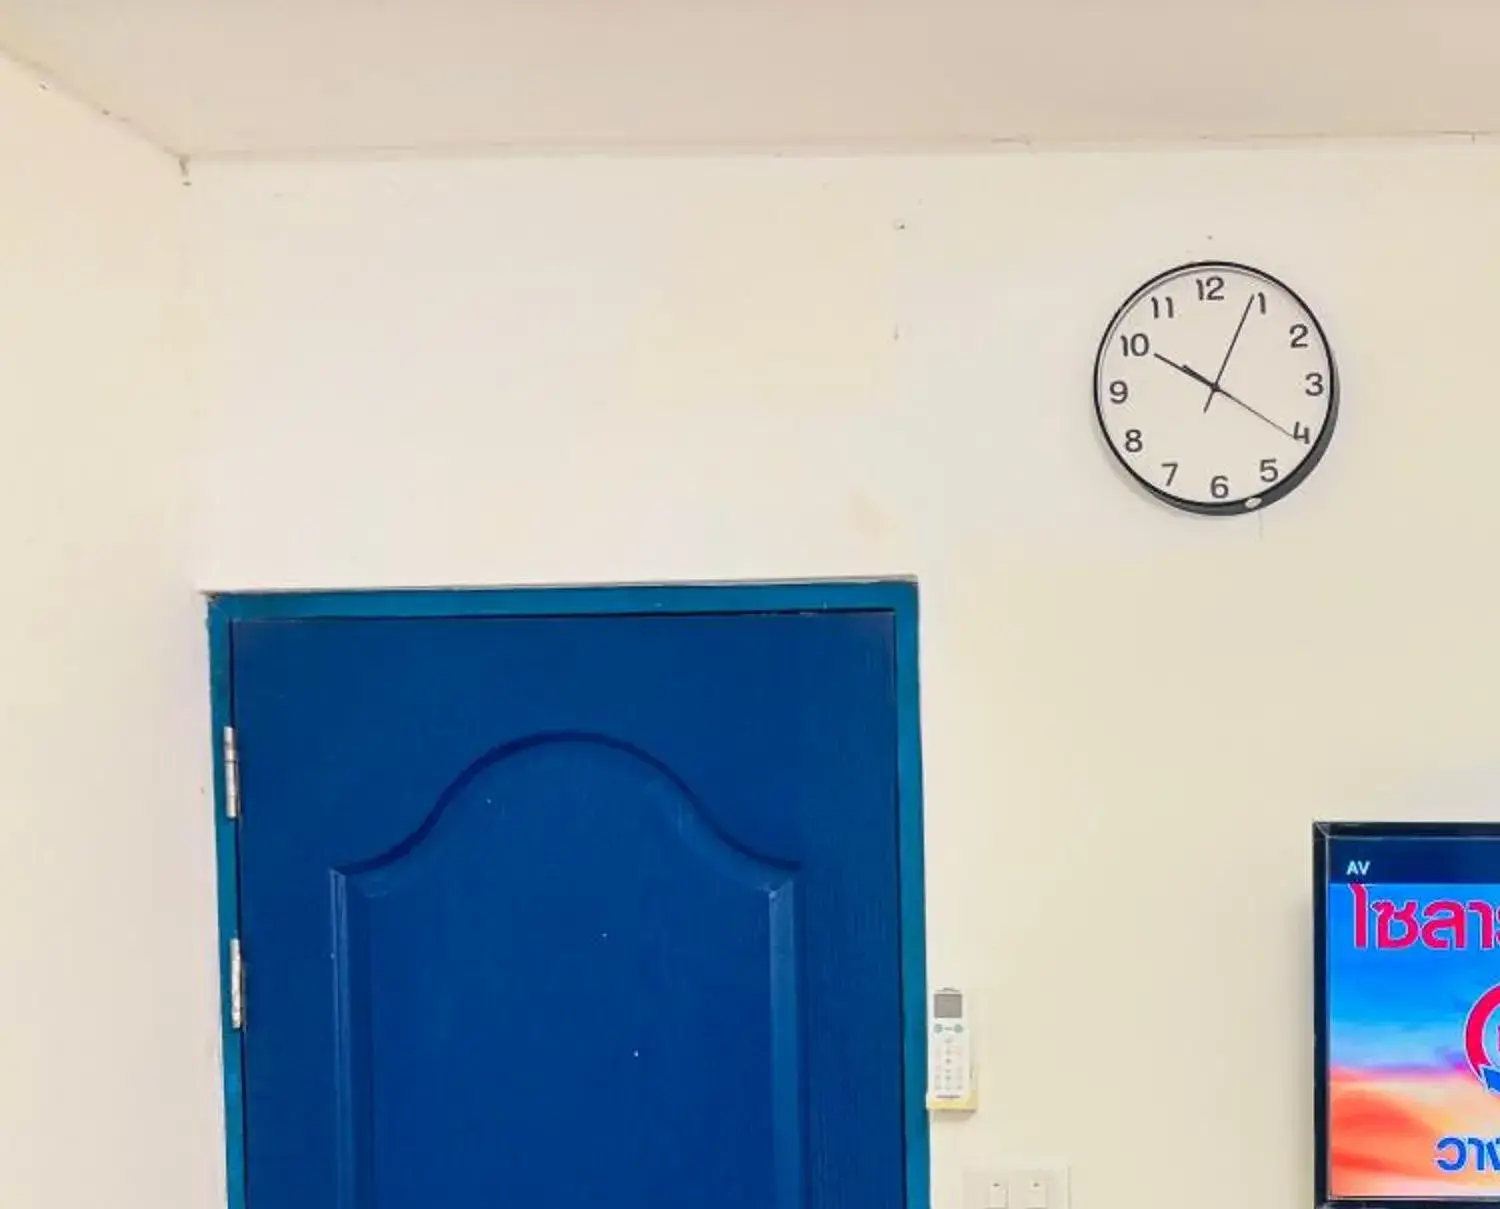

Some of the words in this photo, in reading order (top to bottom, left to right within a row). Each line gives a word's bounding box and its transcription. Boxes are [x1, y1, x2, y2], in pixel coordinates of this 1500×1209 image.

[1196, 276, 1225, 301] 12
[1151, 296, 1174, 319] 11
[1257, 292, 1267, 315] 1
[1120, 333, 1150, 357] 10
[1289, 323, 1309, 349] 2
[1109, 380, 1128, 404] 9
[1305, 372, 1324, 397] 3
[1125, 429, 1143, 453] 8
[1293, 421, 1311, 444] 4
[1161, 462, 1179, 487] 7
[1259, 458, 1279, 482] 5
[1210, 475, 1229, 499] 6
[1346, 860, 1371, 876] AV
